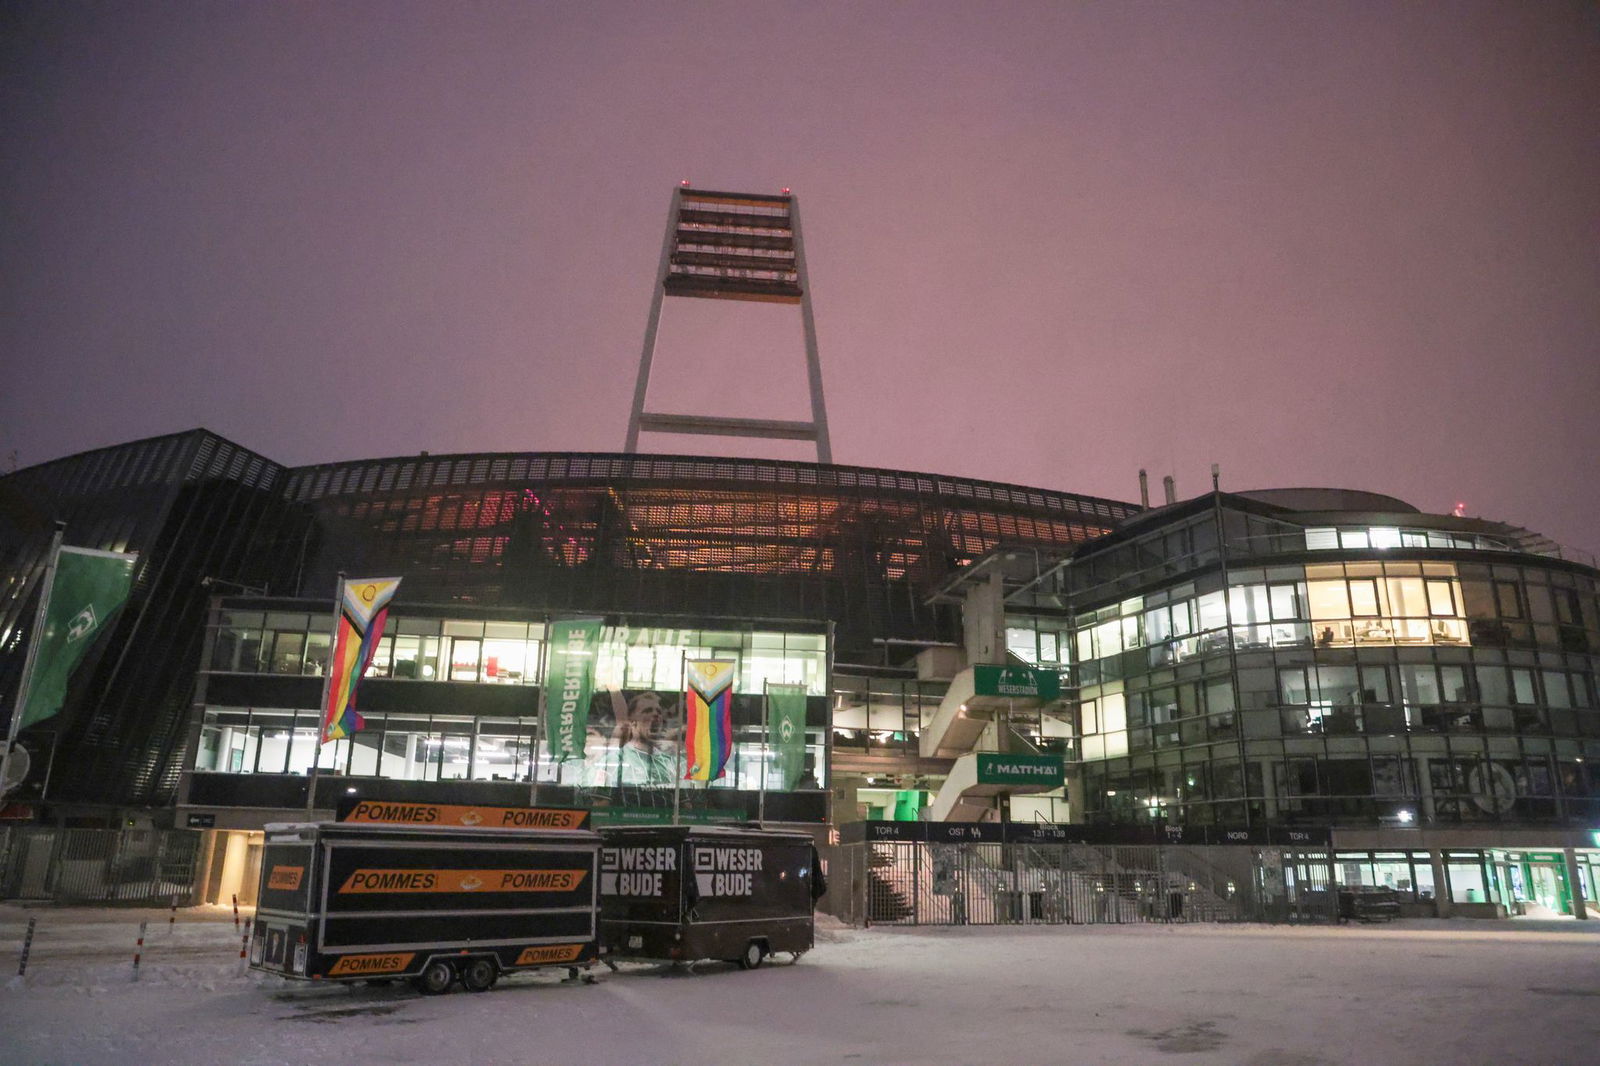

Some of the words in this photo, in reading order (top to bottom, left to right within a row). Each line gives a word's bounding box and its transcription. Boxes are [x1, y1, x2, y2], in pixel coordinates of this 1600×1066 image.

[997, 764, 1057, 775] MATTHÄI
[355, 804, 437, 822] POMMES
[502, 811, 571, 827] POMMES
[875, 826, 893, 835] TOR
[948, 828, 965, 836] OST
[620, 847, 677, 871] WESER
[716, 849, 763, 871] WESER
[351, 873, 435, 889] POMMES
[501, 874, 571, 889] POMMES
[619, 873, 662, 897] BUDE
[715, 874, 752, 896] BUDE
[525, 948, 573, 961] POMMES
[340, 957, 400, 971] POMMES
